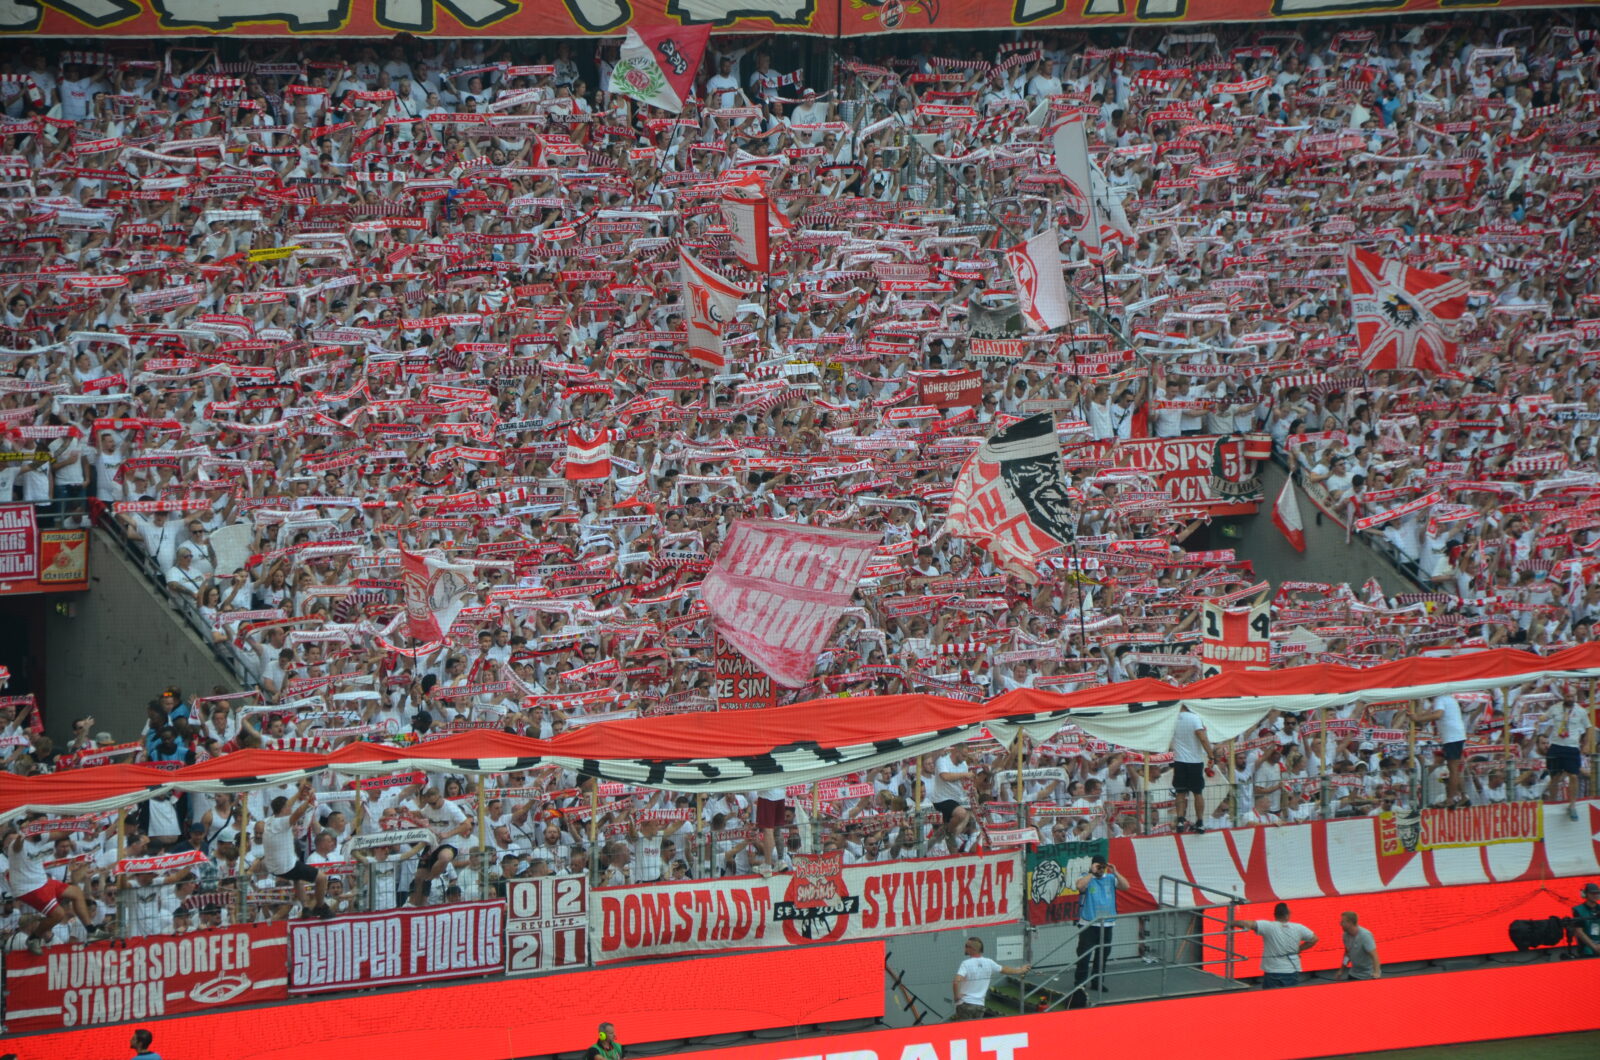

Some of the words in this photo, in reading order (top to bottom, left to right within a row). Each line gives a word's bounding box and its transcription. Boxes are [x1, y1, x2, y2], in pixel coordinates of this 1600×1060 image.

[456, 114, 482, 122] KÖLN
[971, 340, 1023, 356] CHAOTIX
[1083, 352, 1122, 364] CHAOTIX
[956, 377, 982, 391] JUNGS
[825, 467, 839, 475] FC
[841, 461, 873, 473] KÖLN
[1163, 443, 1213, 472] SPS
[1163, 476, 1213, 502] CGN
[117, 502, 157, 512] COME
[163, 502, 180, 511] ON
[680, 551, 706, 560] KÖLN
[1205, 610, 1220, 637] 1
[738, 676, 771, 699] SIN!
[367, 780, 381, 788] FC
[383, 776, 413, 786] KÖLN
[1420, 802, 1539, 846] STADIONVERBOT
[601, 885, 772, 952] DOMSTADT
[862, 864, 1015, 930] SYNDIKAT
[293, 916, 403, 987] SEMPER
[410, 907, 500, 975] FIDELIS
[47, 932, 252, 991] MÜNGERSDORFER
[62, 980, 166, 1027] STADION
